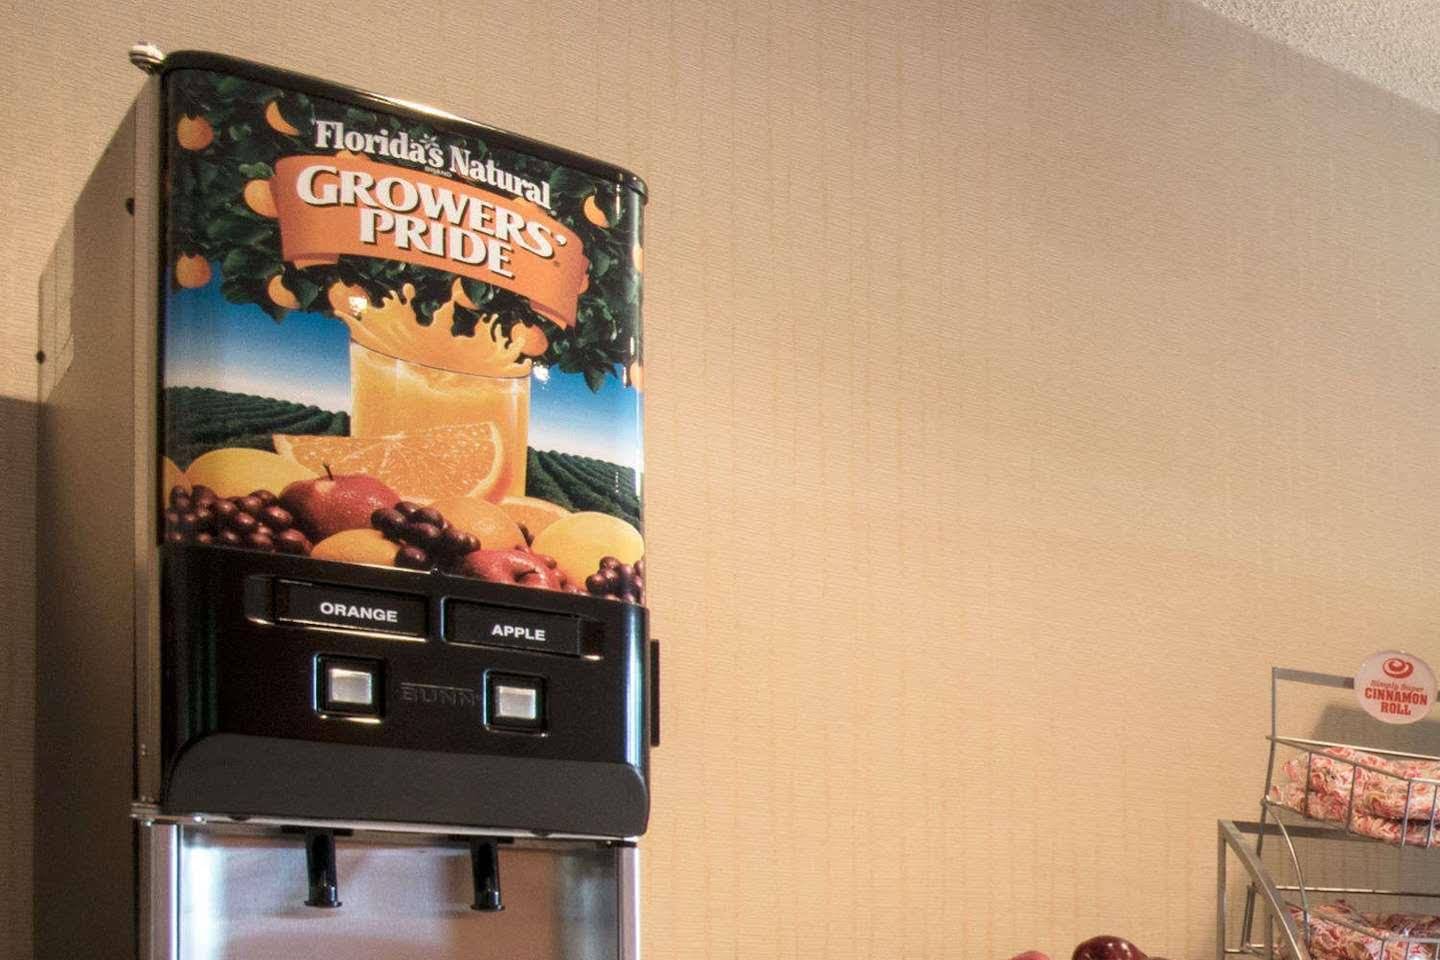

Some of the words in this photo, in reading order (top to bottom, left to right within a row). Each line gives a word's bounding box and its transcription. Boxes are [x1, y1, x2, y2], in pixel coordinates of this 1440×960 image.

[314, 119, 445, 168] Florida's
[449, 146, 552, 210] Natural
[359, 209, 515, 278] PRIDE
[320, 601, 399, 624] ORANGE
[491, 623, 547, 643] APPLE
[1364, 687, 1428, 706] CINNAMON
[1380, 702, 1412, 716] ROLL
